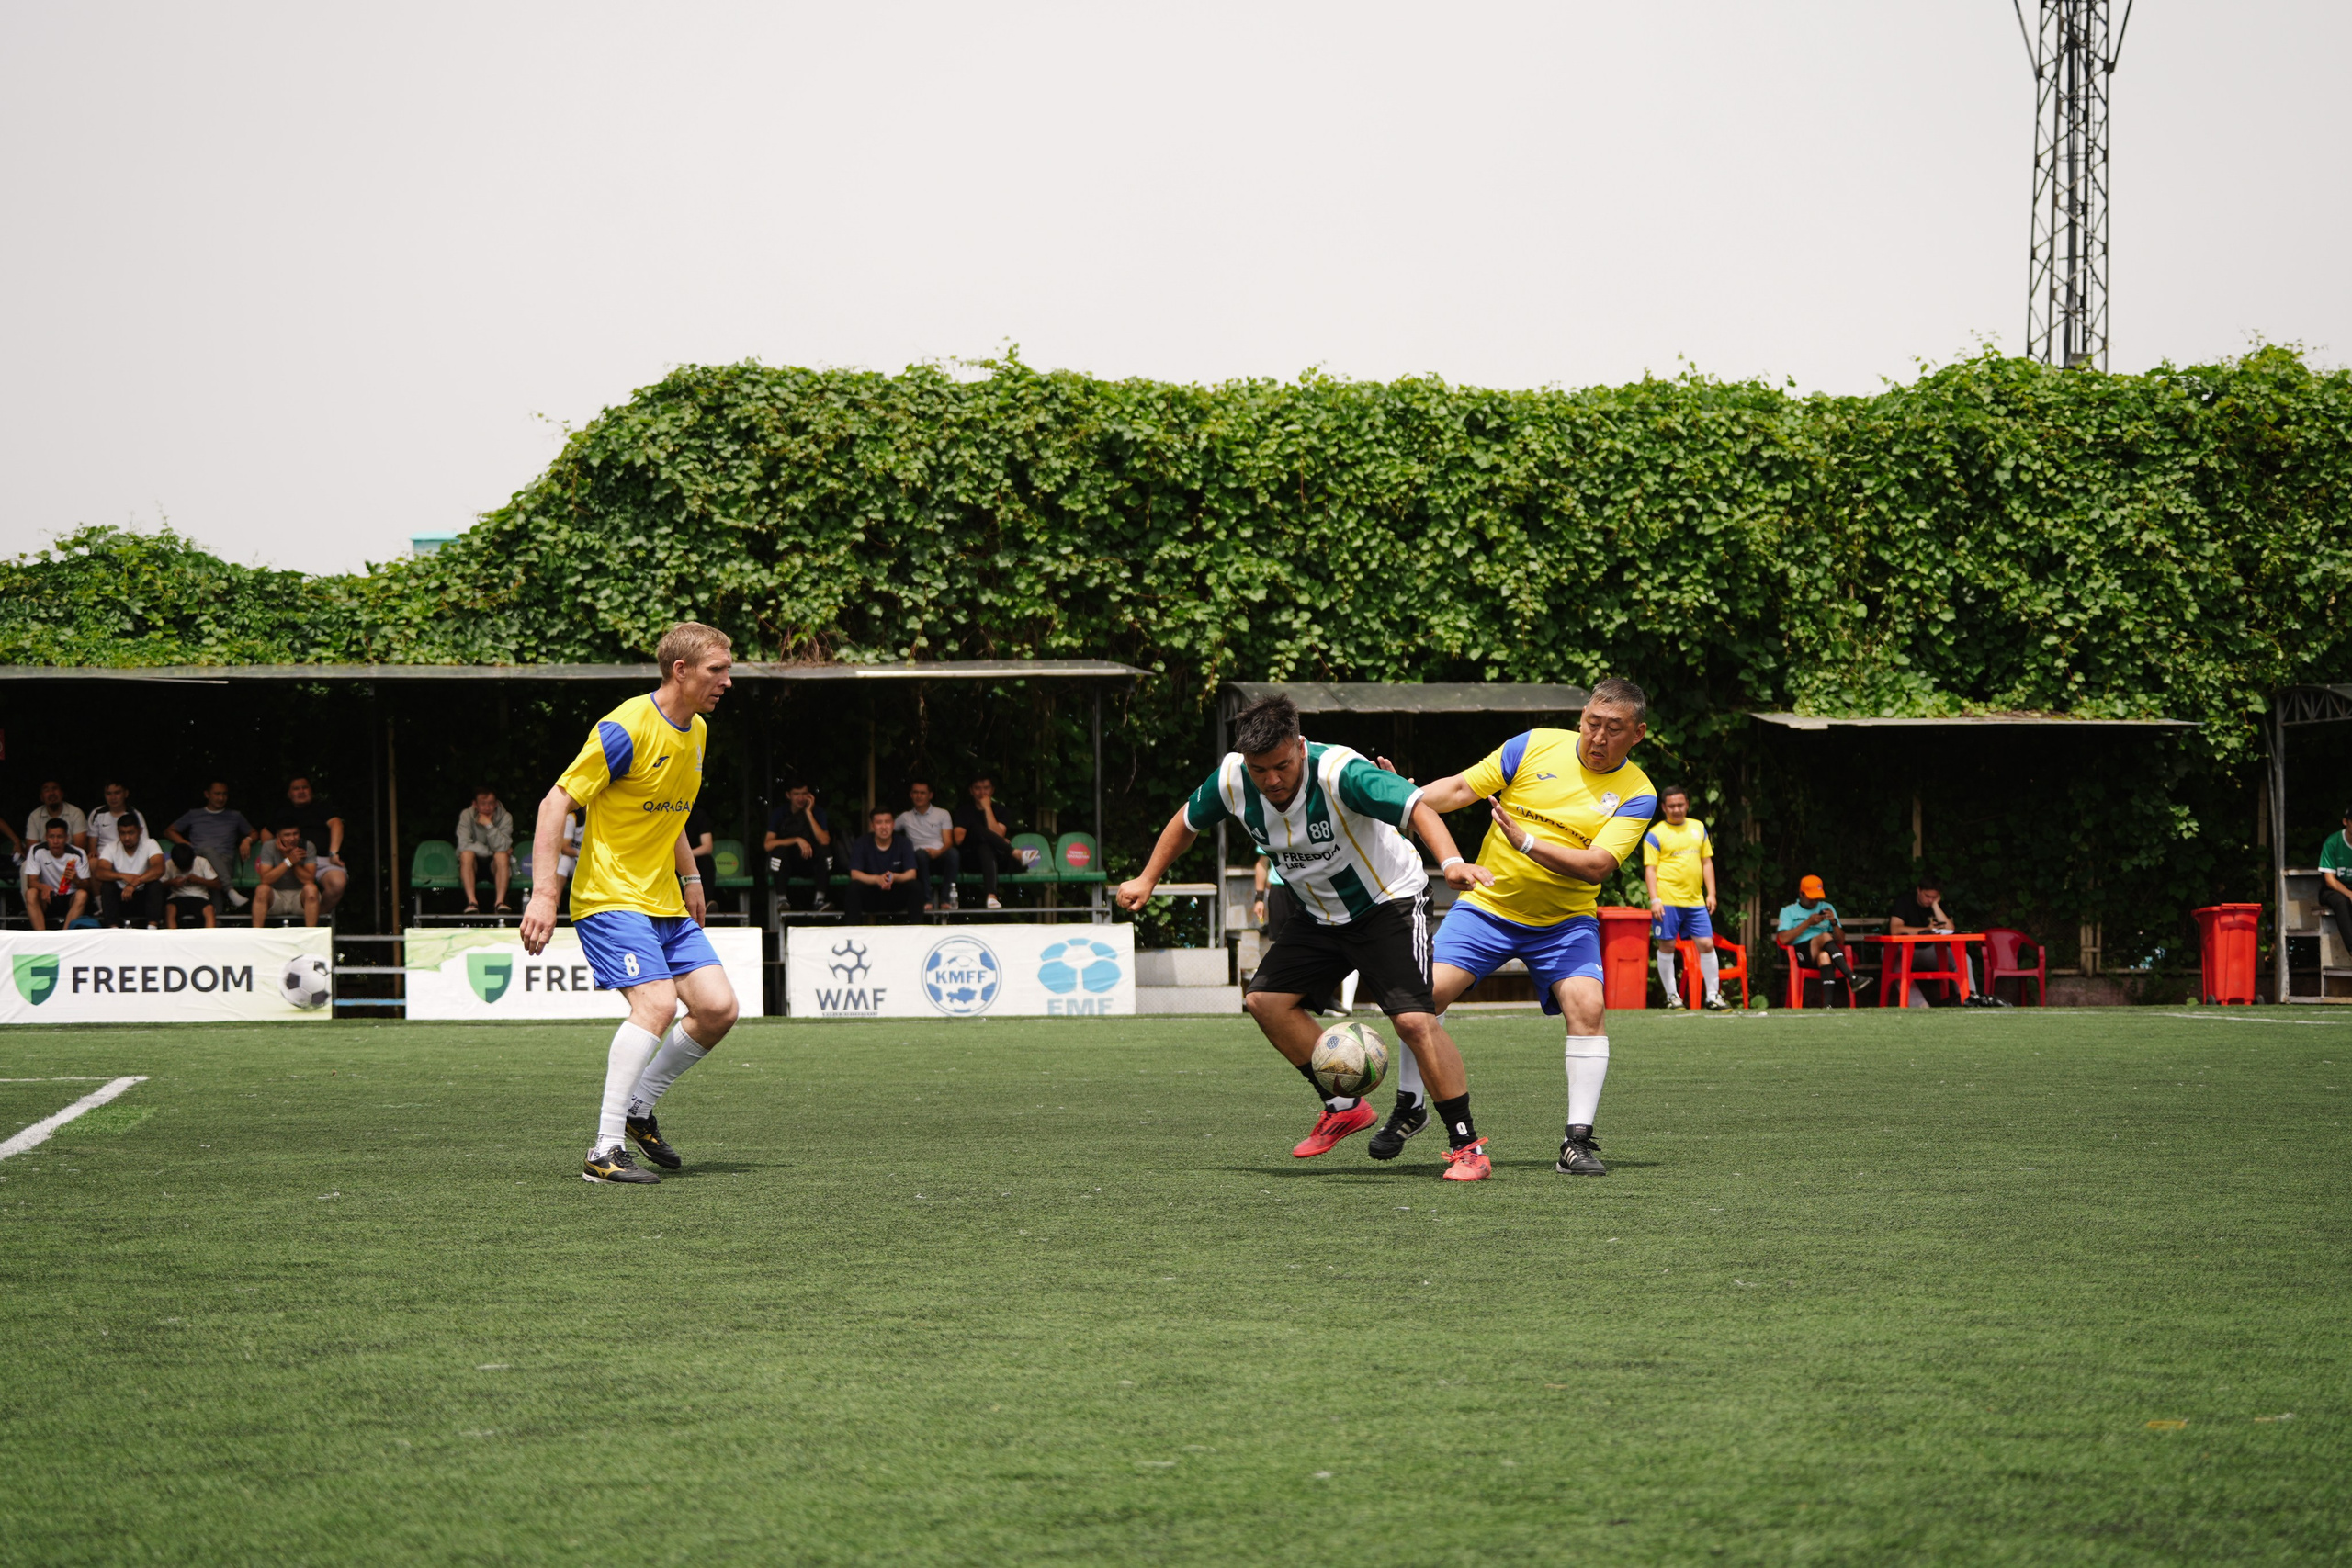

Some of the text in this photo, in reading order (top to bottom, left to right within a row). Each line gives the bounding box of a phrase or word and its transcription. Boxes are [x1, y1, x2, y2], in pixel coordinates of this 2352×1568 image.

[1309, 820, 1330, 840] 88
[1283, 843, 1341, 861] FREEDOM
[623, 953, 640, 977] 8
[72, 965, 253, 994] FREEDOM
[526, 965, 612, 992] FRE
[935, 970, 988, 984] KMFF
[815, 988, 888, 1010] WMF
[1047, 998, 1114, 1016] EMF
